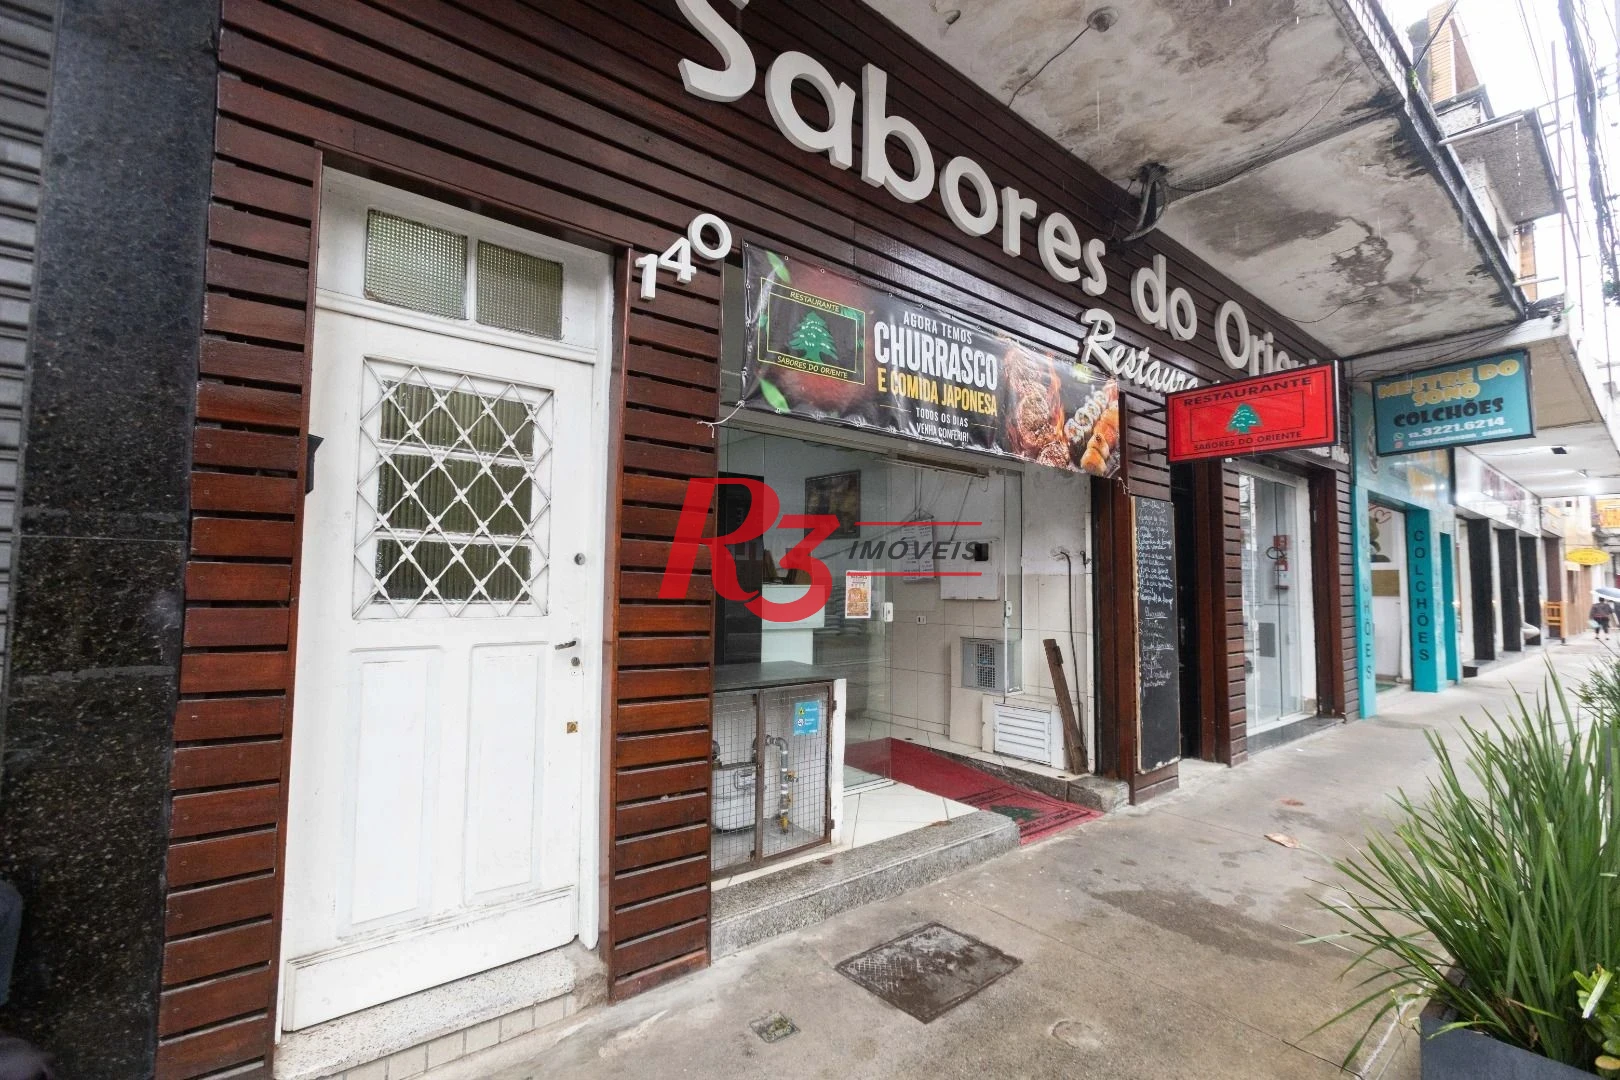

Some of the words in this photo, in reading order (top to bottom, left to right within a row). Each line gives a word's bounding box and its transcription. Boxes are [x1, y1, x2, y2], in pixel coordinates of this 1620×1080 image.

[678, 0, 1106, 296] Sabores
[1131, 254, 1197, 341] do
[1215, 300, 1317, 376] Orie
[790, 291, 840, 313] RESTAURANTE
[903, 311, 938, 334] AGORA
[941, 322, 972, 345] TEMOS
[777, 355, 807, 371] SABORES
[808, 363, 819, 373] DO
[820, 366, 848, 379] ORIENTE
[873, 321, 998, 391] CHURRASCO
[877, 367, 887, 393] E
[890, 370, 939, 404] COMIDA
[941, 383, 998, 417] JAPONESA
[1183, 376, 1312, 407] RESTAURANTE
[1377, 368, 1474, 399] MESTRE
[1478, 359, 1520, 381] DO
[1411, 382, 1481, 407] SONO
[915, 407, 939, 422] TODOS
[941, 412, 950, 424] OS
[952, 415, 969, 428] DIAS
[1394, 397, 1504, 428] COLCHÕES
[916, 422, 937, 437] VENHA
[938, 427, 969, 443] CONFERIR!
[1193, 438, 1236, 451] SABORES
[1238, 436, 1254, 445] DO
[1257, 431, 1303, 445] ORIENTE
